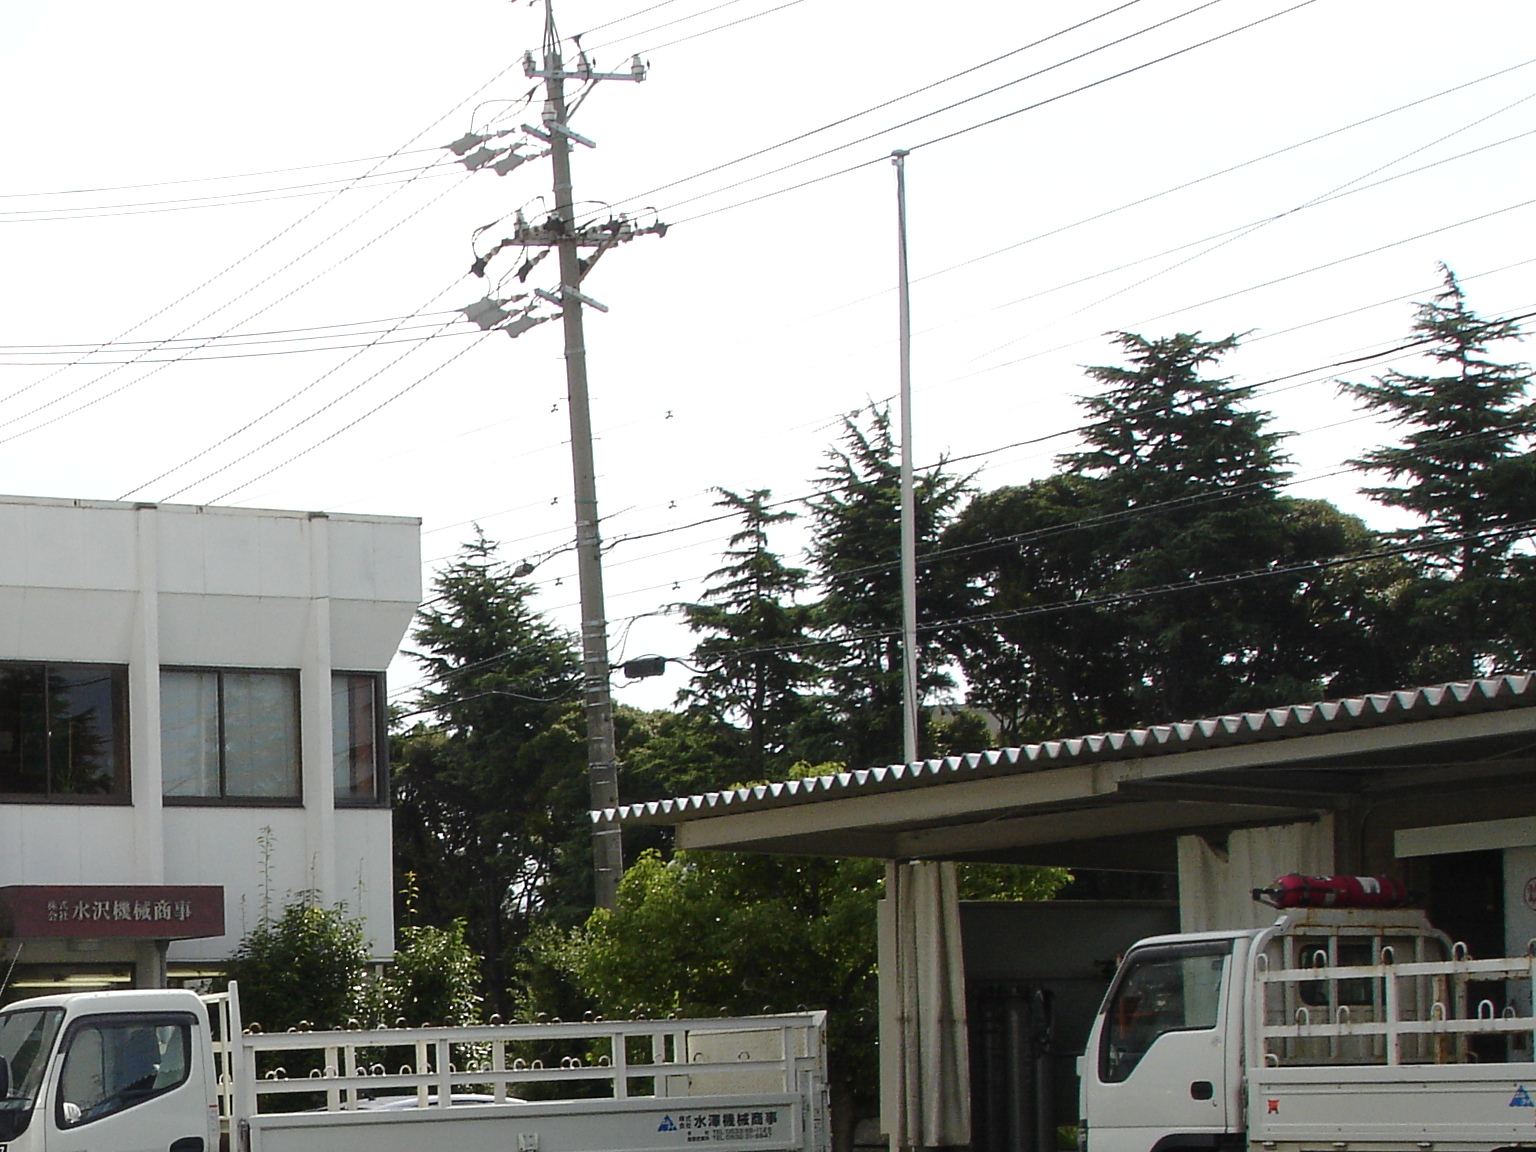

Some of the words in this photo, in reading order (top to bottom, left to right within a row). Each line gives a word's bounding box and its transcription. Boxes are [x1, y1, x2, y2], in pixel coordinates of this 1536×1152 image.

[72, 900, 192, 921] 水沢機械商事
